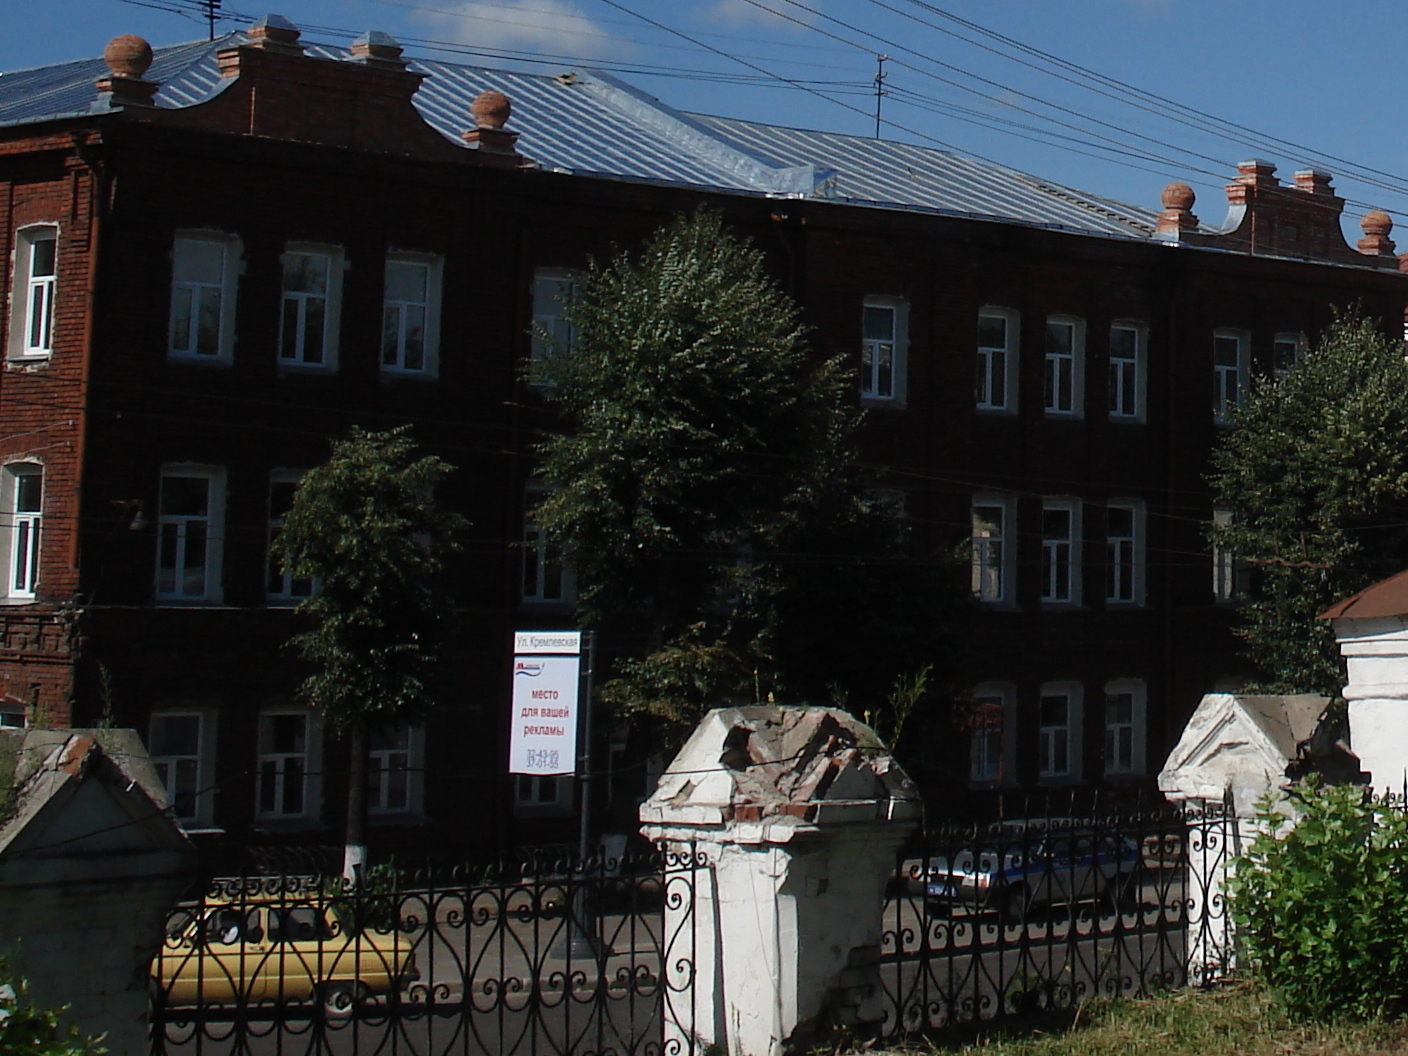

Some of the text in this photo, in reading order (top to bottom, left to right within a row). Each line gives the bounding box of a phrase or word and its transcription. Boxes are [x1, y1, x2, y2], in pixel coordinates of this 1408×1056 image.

[532, 690, 559, 700] место
[521, 706, 569, 719] для вашей
[524, 725, 565, 737] рекламы
